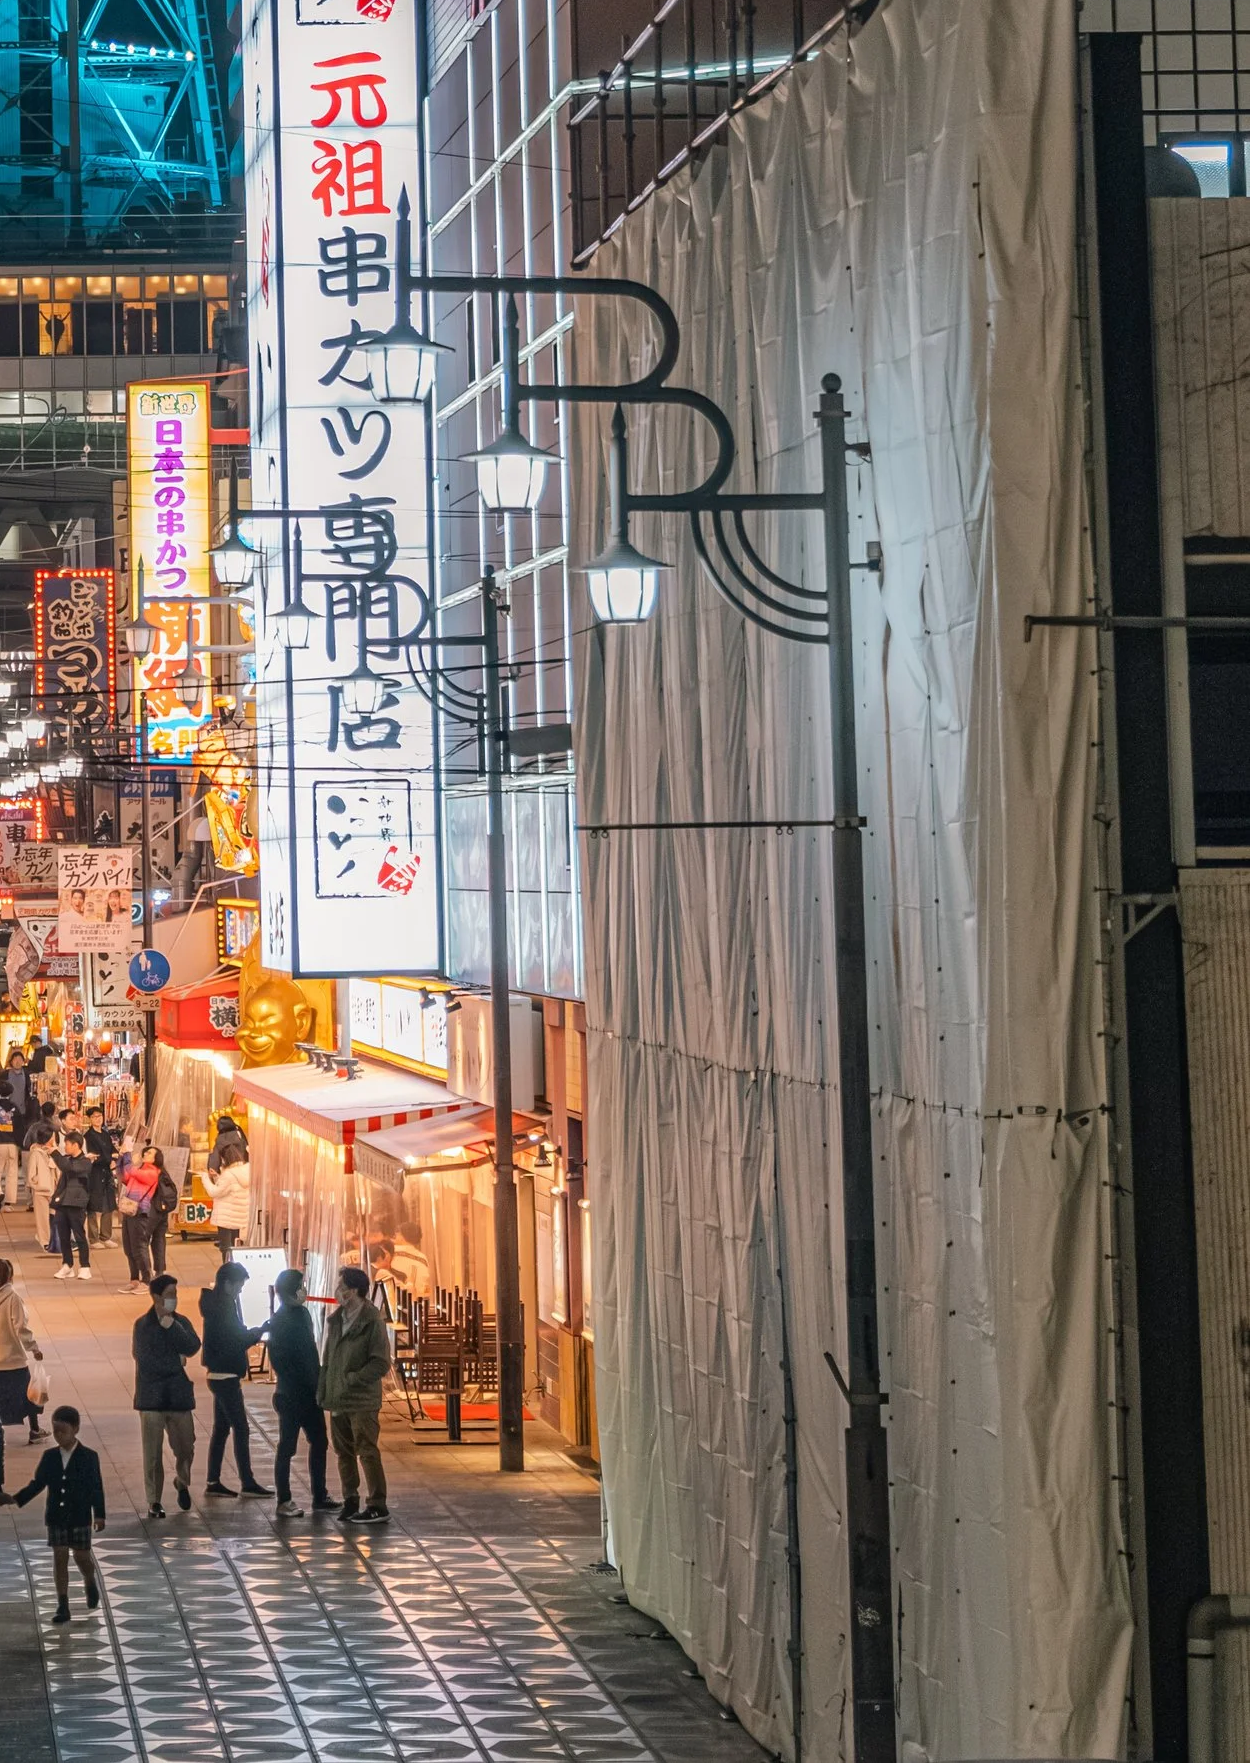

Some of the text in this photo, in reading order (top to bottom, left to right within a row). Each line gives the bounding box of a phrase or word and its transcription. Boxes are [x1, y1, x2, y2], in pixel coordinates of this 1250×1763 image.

[154, 419, 188, 590] 日本一の串かつ
[21, 846, 53, 862] 忘年
[59, 852, 99, 871] 忘年
[211, 1005, 240, 1028] 横
